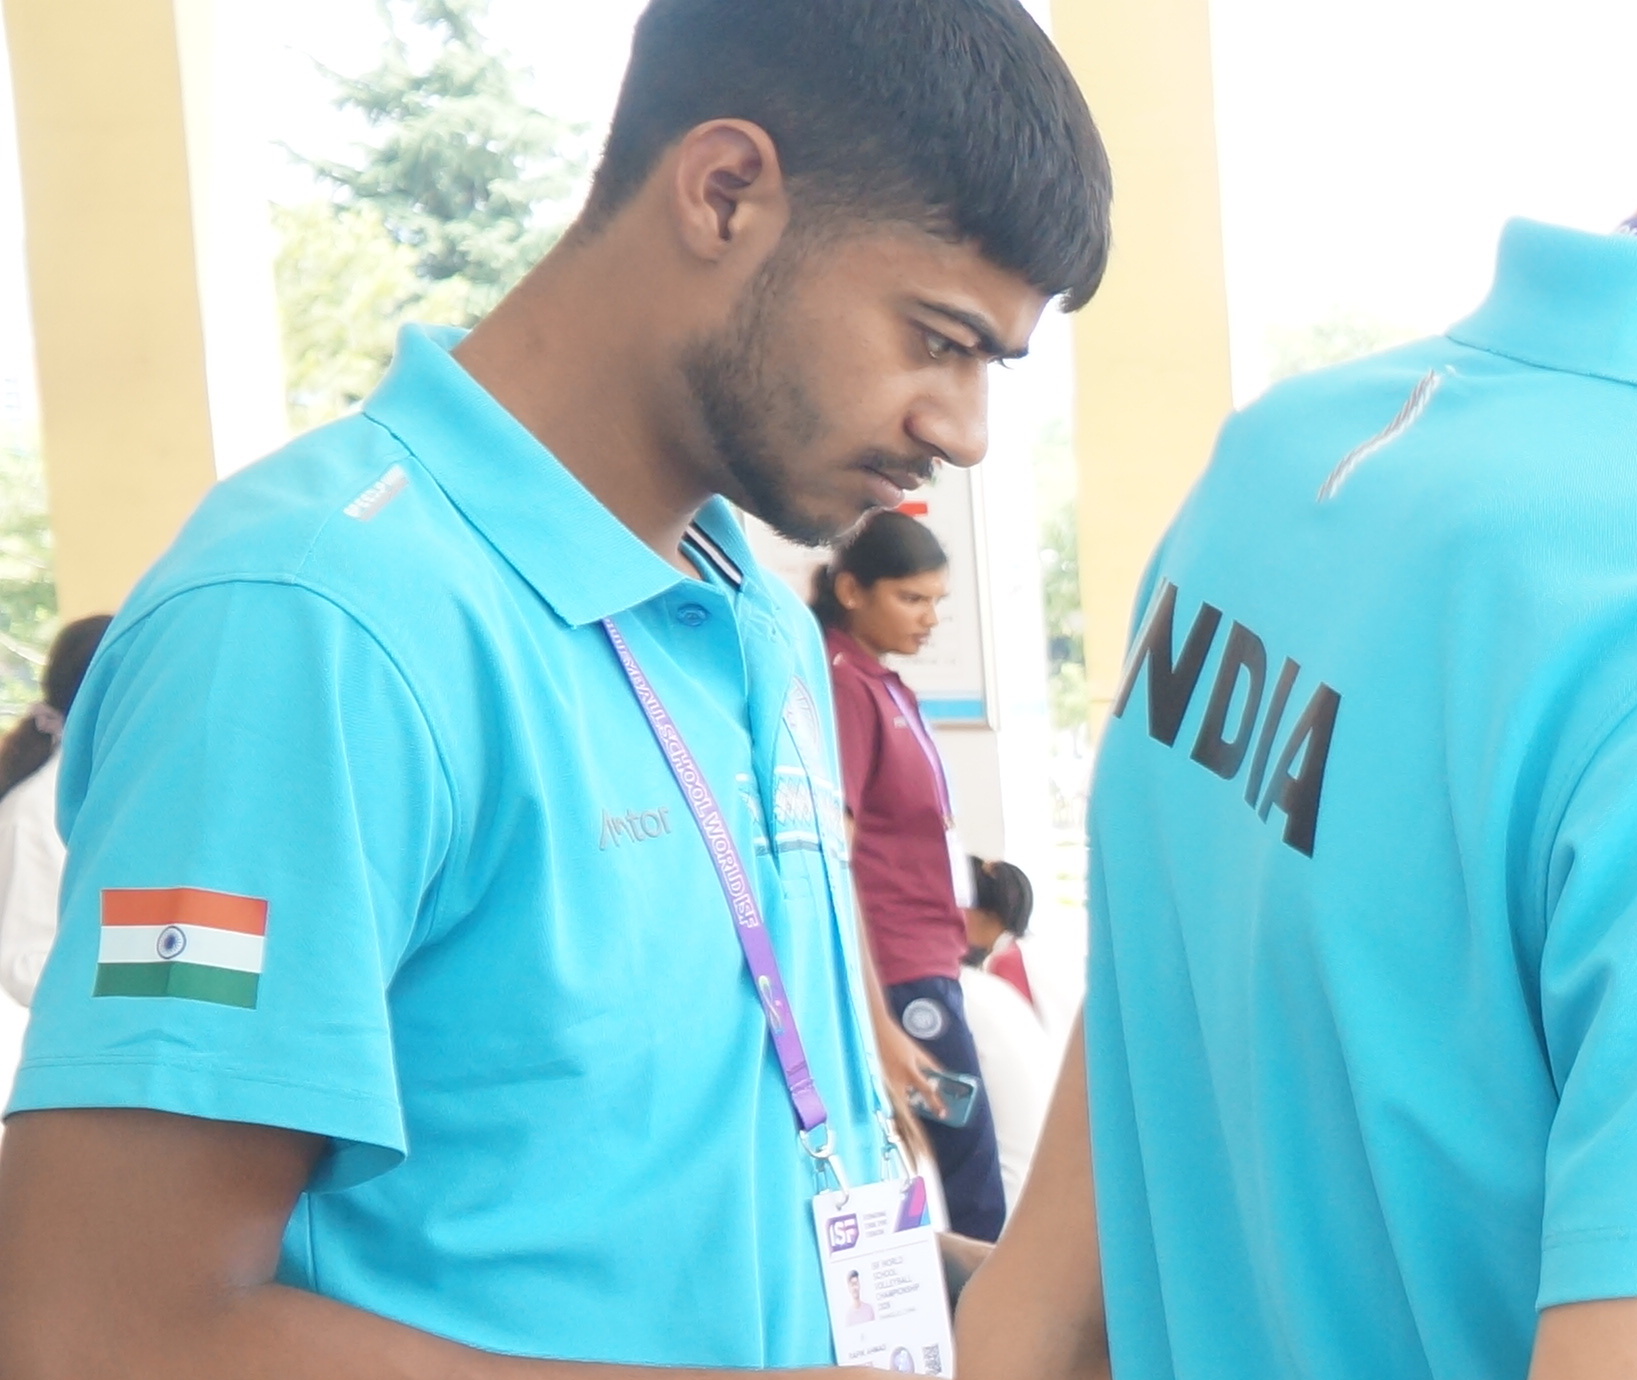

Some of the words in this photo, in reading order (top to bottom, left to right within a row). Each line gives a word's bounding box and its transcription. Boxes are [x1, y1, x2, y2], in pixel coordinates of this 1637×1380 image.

[1113, 577, 1342, 859] NDIA
[700, 811, 746, 896] WORLD
[733, 893, 759, 928] ISF
[829, 1218, 858, 1247] ISF
